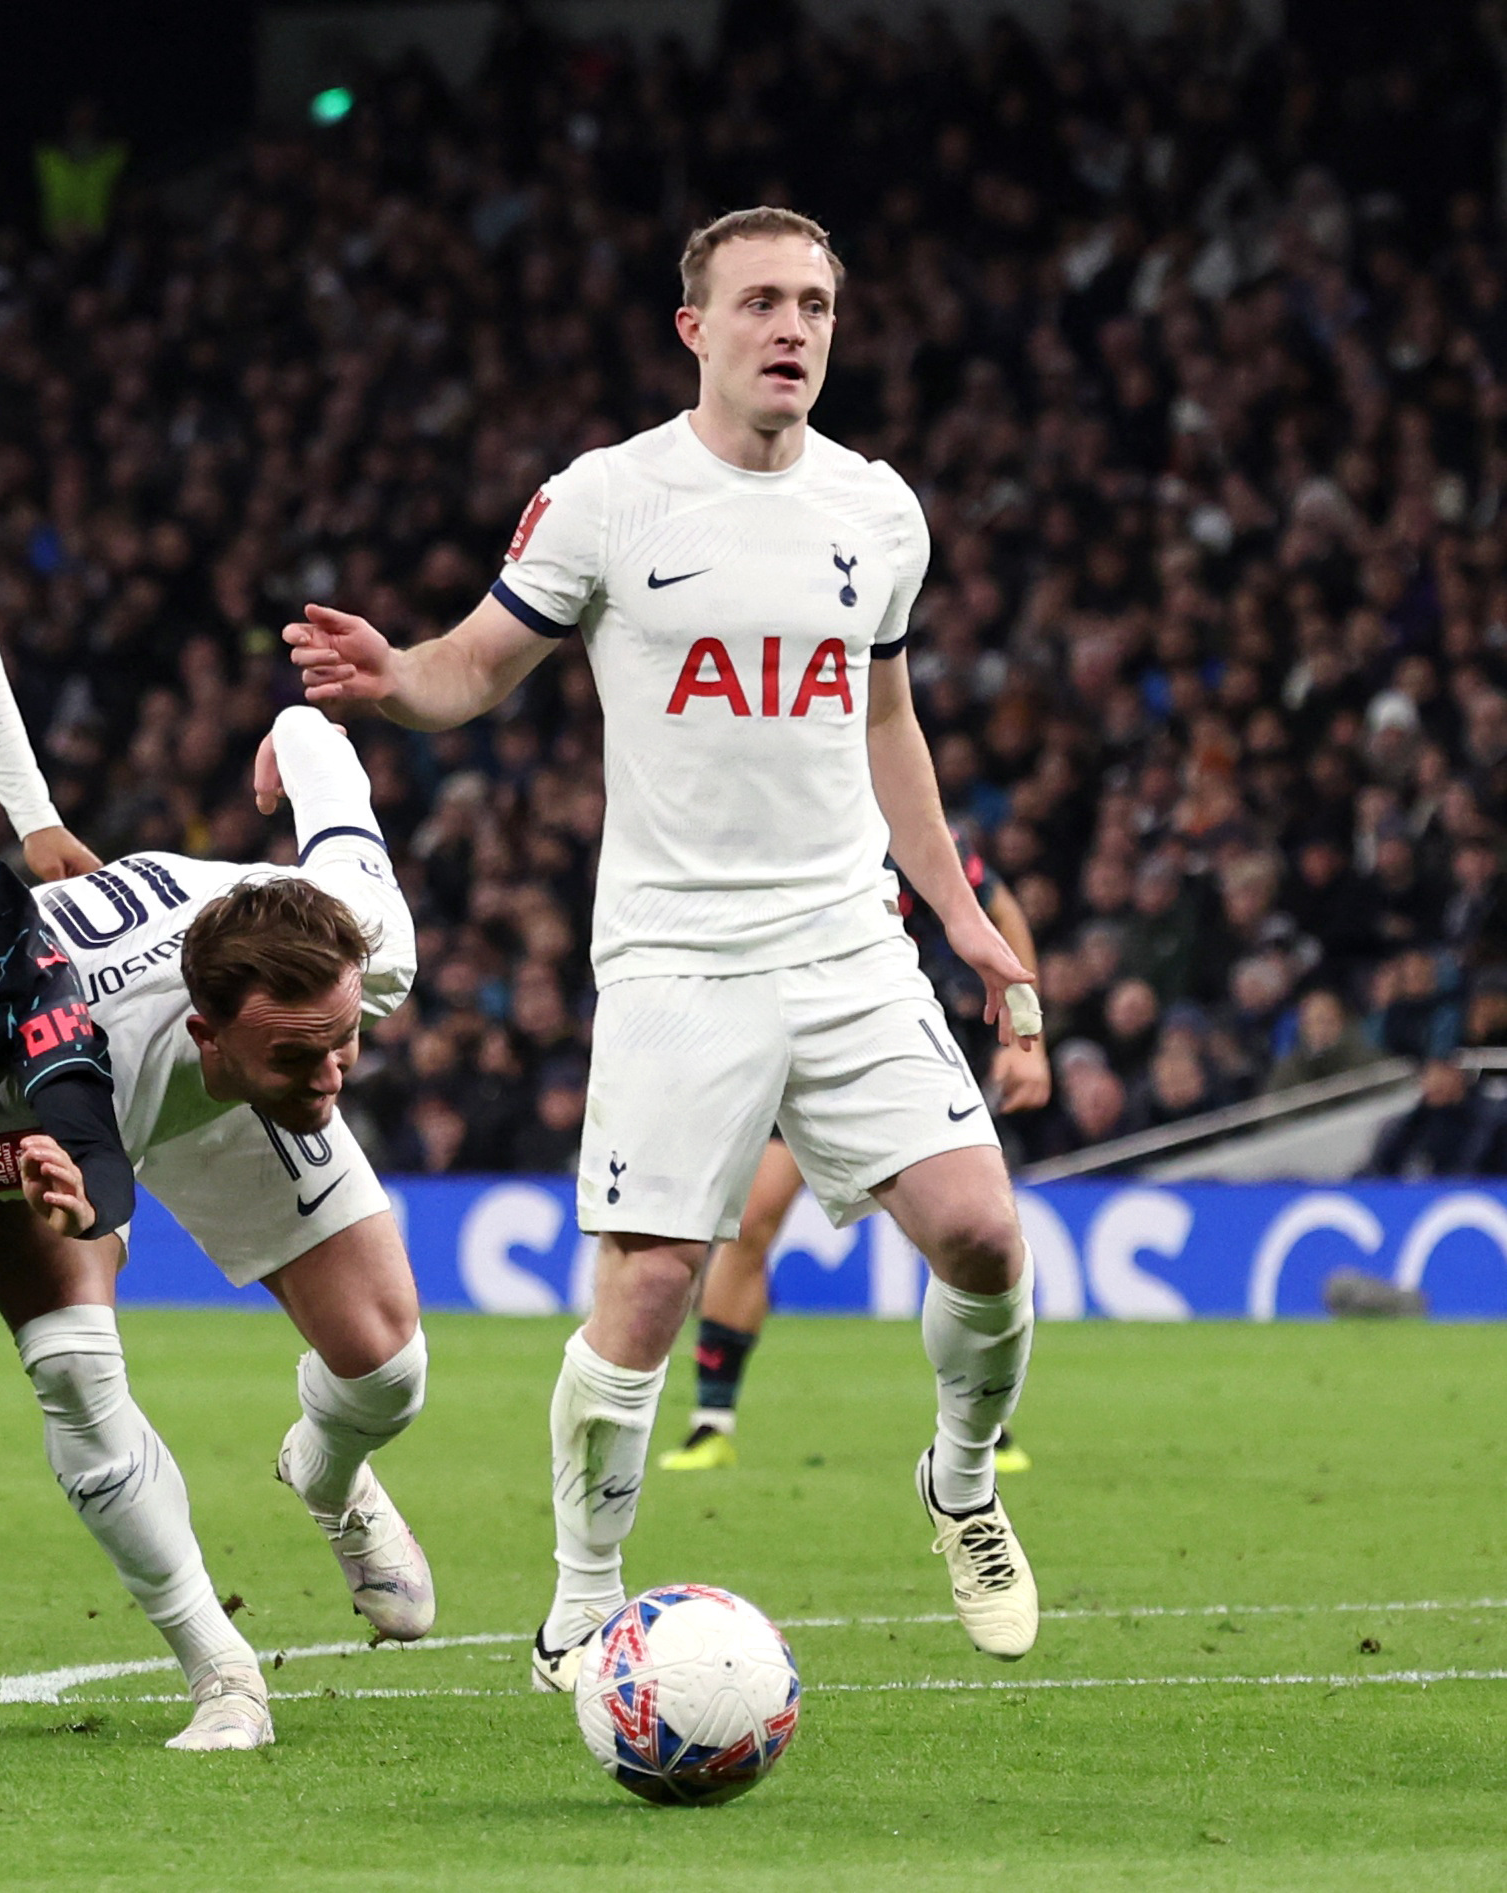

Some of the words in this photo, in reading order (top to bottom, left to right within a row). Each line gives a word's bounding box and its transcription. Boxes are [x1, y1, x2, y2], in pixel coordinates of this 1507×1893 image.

[665, 636, 854, 718] AIA
[40, 858, 191, 950] 10
[918, 1018, 972, 1089] 4
[1, 1142, 17, 1183] Emirates
[250, 1104, 332, 1182] 10
